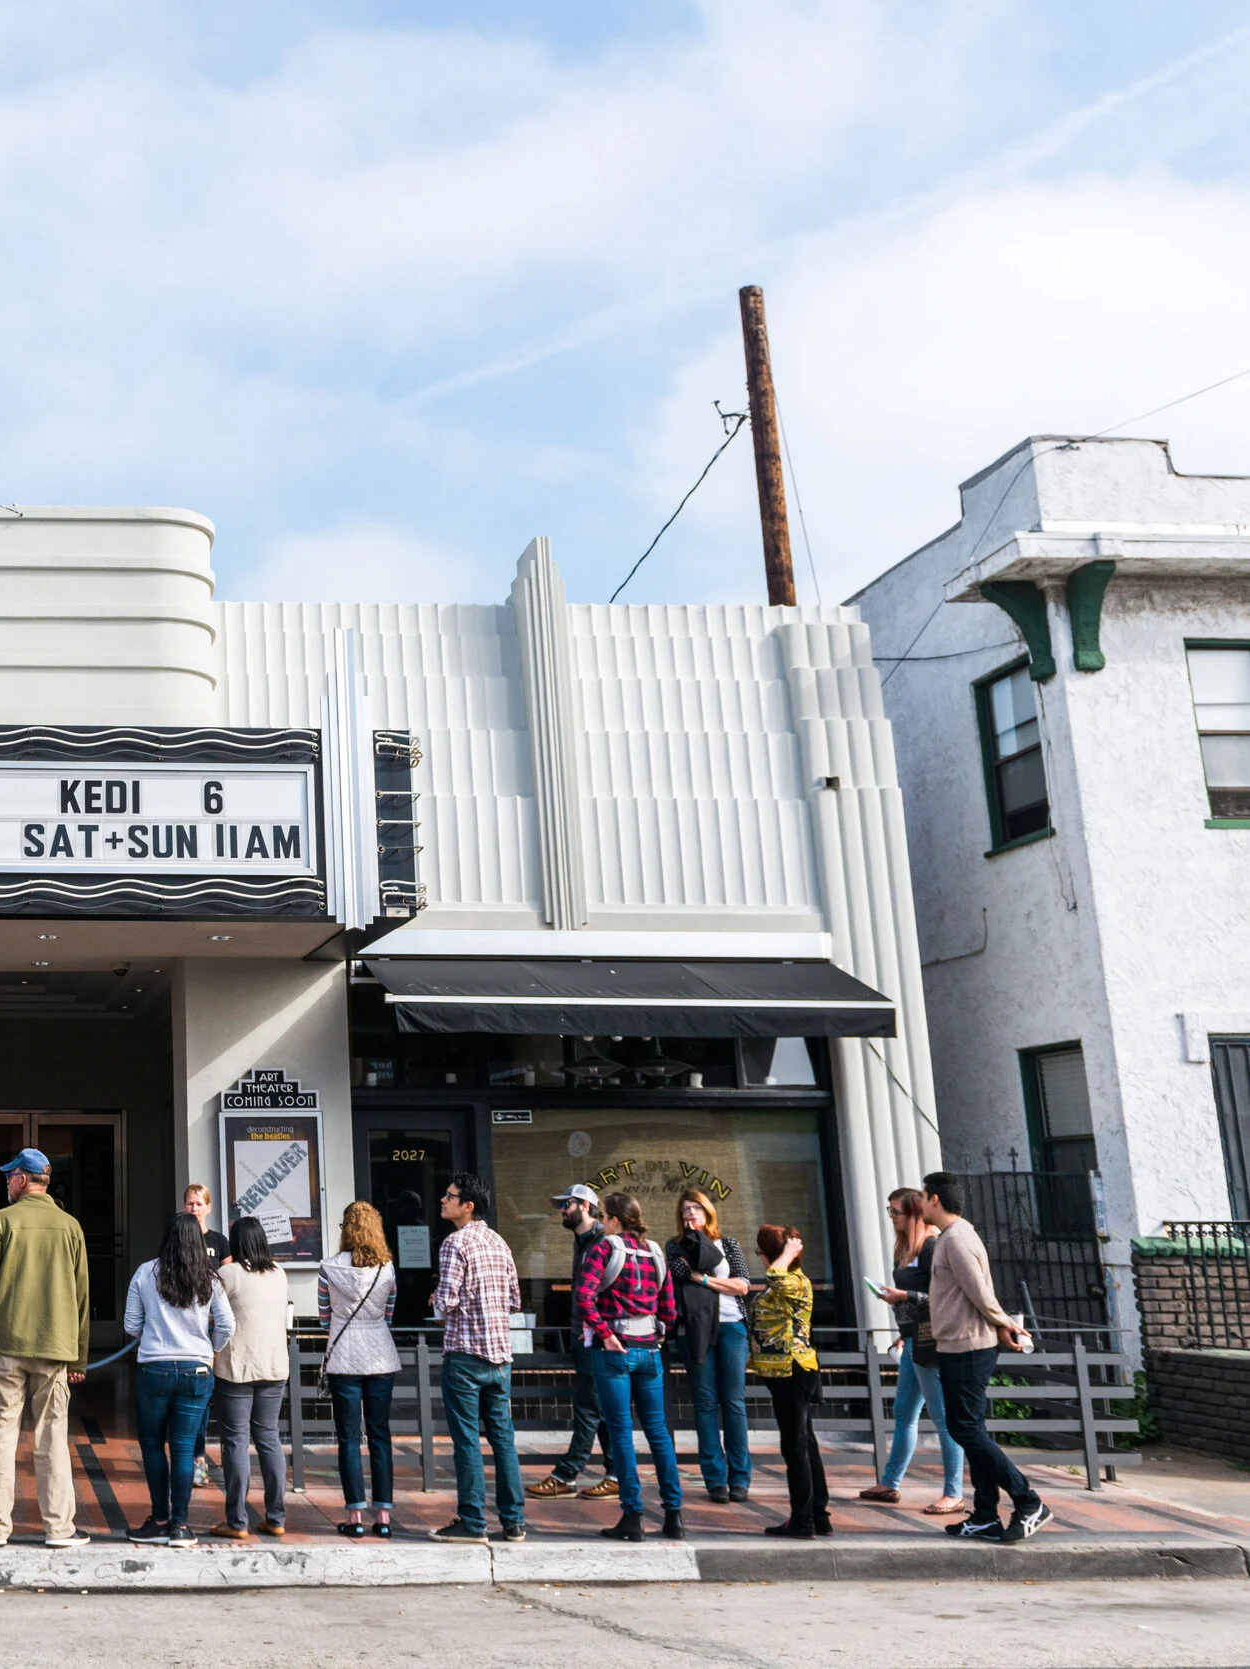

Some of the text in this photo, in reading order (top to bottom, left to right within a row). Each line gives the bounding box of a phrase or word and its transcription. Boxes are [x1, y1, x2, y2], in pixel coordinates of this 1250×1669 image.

[60, 779, 140, 814] KEDI
[204, 780, 223, 815] 6
[24, 823, 197, 859] SAT+SUN
[259, 1072, 279, 1082] ART
[245, 1083, 294, 1094] THEATER
[226, 1095, 314, 1107] COMING SOON
[246, 1125, 294, 1135] deconstructing
[250, 1132, 291, 1140] the beatles
[392, 1149, 425, 1161] 2027
[236, 1141, 308, 1215] REVOLVER
[645, 1160, 670, 1172] DU
[678, 1160, 733, 1201] VIN
